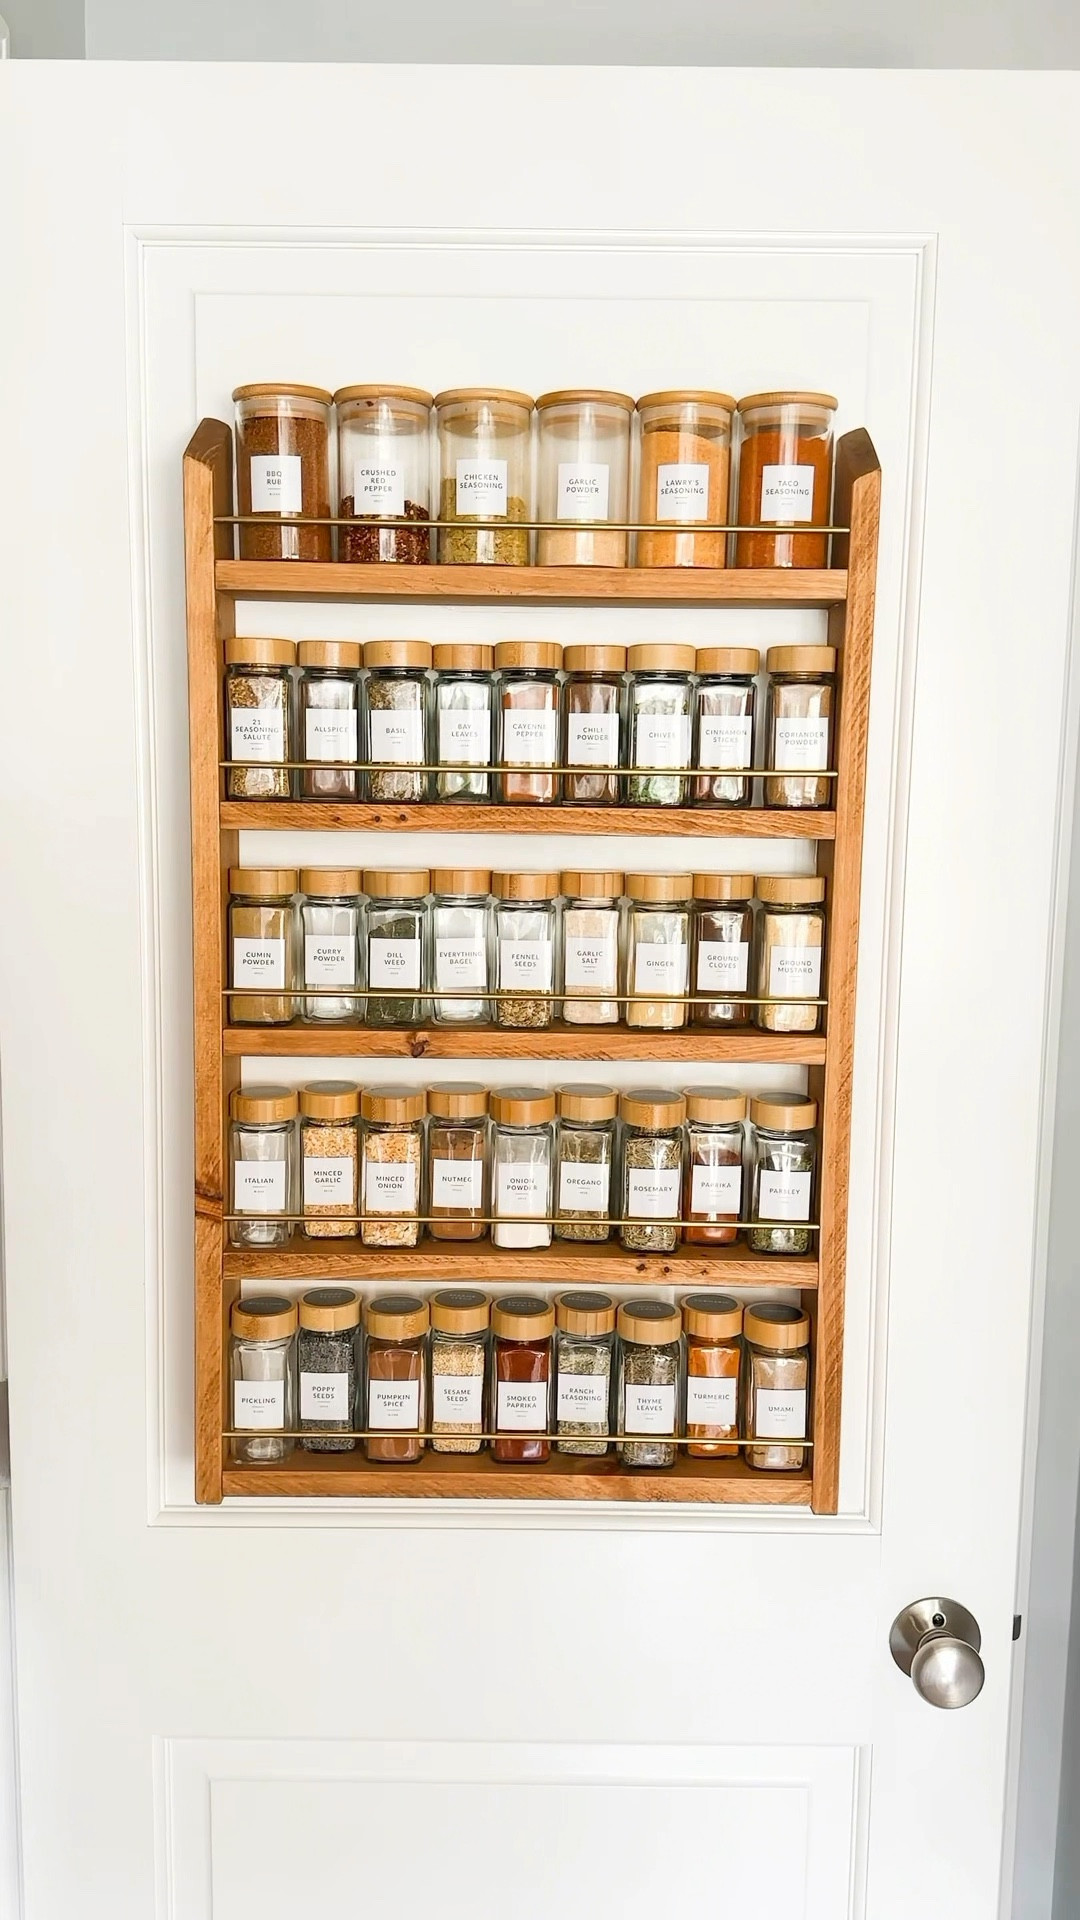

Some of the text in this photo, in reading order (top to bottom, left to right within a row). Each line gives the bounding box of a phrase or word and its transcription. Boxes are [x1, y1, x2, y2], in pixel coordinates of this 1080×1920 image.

[266, 470, 282, 478] BBQ
[360, 469, 397, 477] CRUSHED
[463, 473, 499, 481] CHICKEN
[266, 478, 282, 486] RUB
[459, 481, 503, 490] SEASONING
[568, 478, 598, 486] GARLIC
[665, 479, 700, 487] LAWRY'S
[566, 486, 600, 494] POWDER
[660, 487, 705, 495] SEASONING
[765, 488, 810, 496] SEASONING
[235, 726, 279, 734] SEASONING
[243, 733, 271, 741] SALUTE
[779, 731, 825, 739] CORIANDER
[245, 951, 272, 959] CUMIN
[511, 953, 540, 961] FENNEL
[707, 954, 740, 962] GROUND
[242, 958, 275, 966] POWDER
[646, 960, 675, 968] GINGER
[779, 959, 812, 967] GROUND
[566, 1178, 602, 1186] OREGANO
[633, 1185, 673, 1193] ROSEMARY
[769, 1187, 801, 1195] PARSLEY
[569, 1387, 594, 1395] RANCH
[376, 1393, 411, 1401] PUMPKIN
[637, 1397, 662, 1405] THYME
